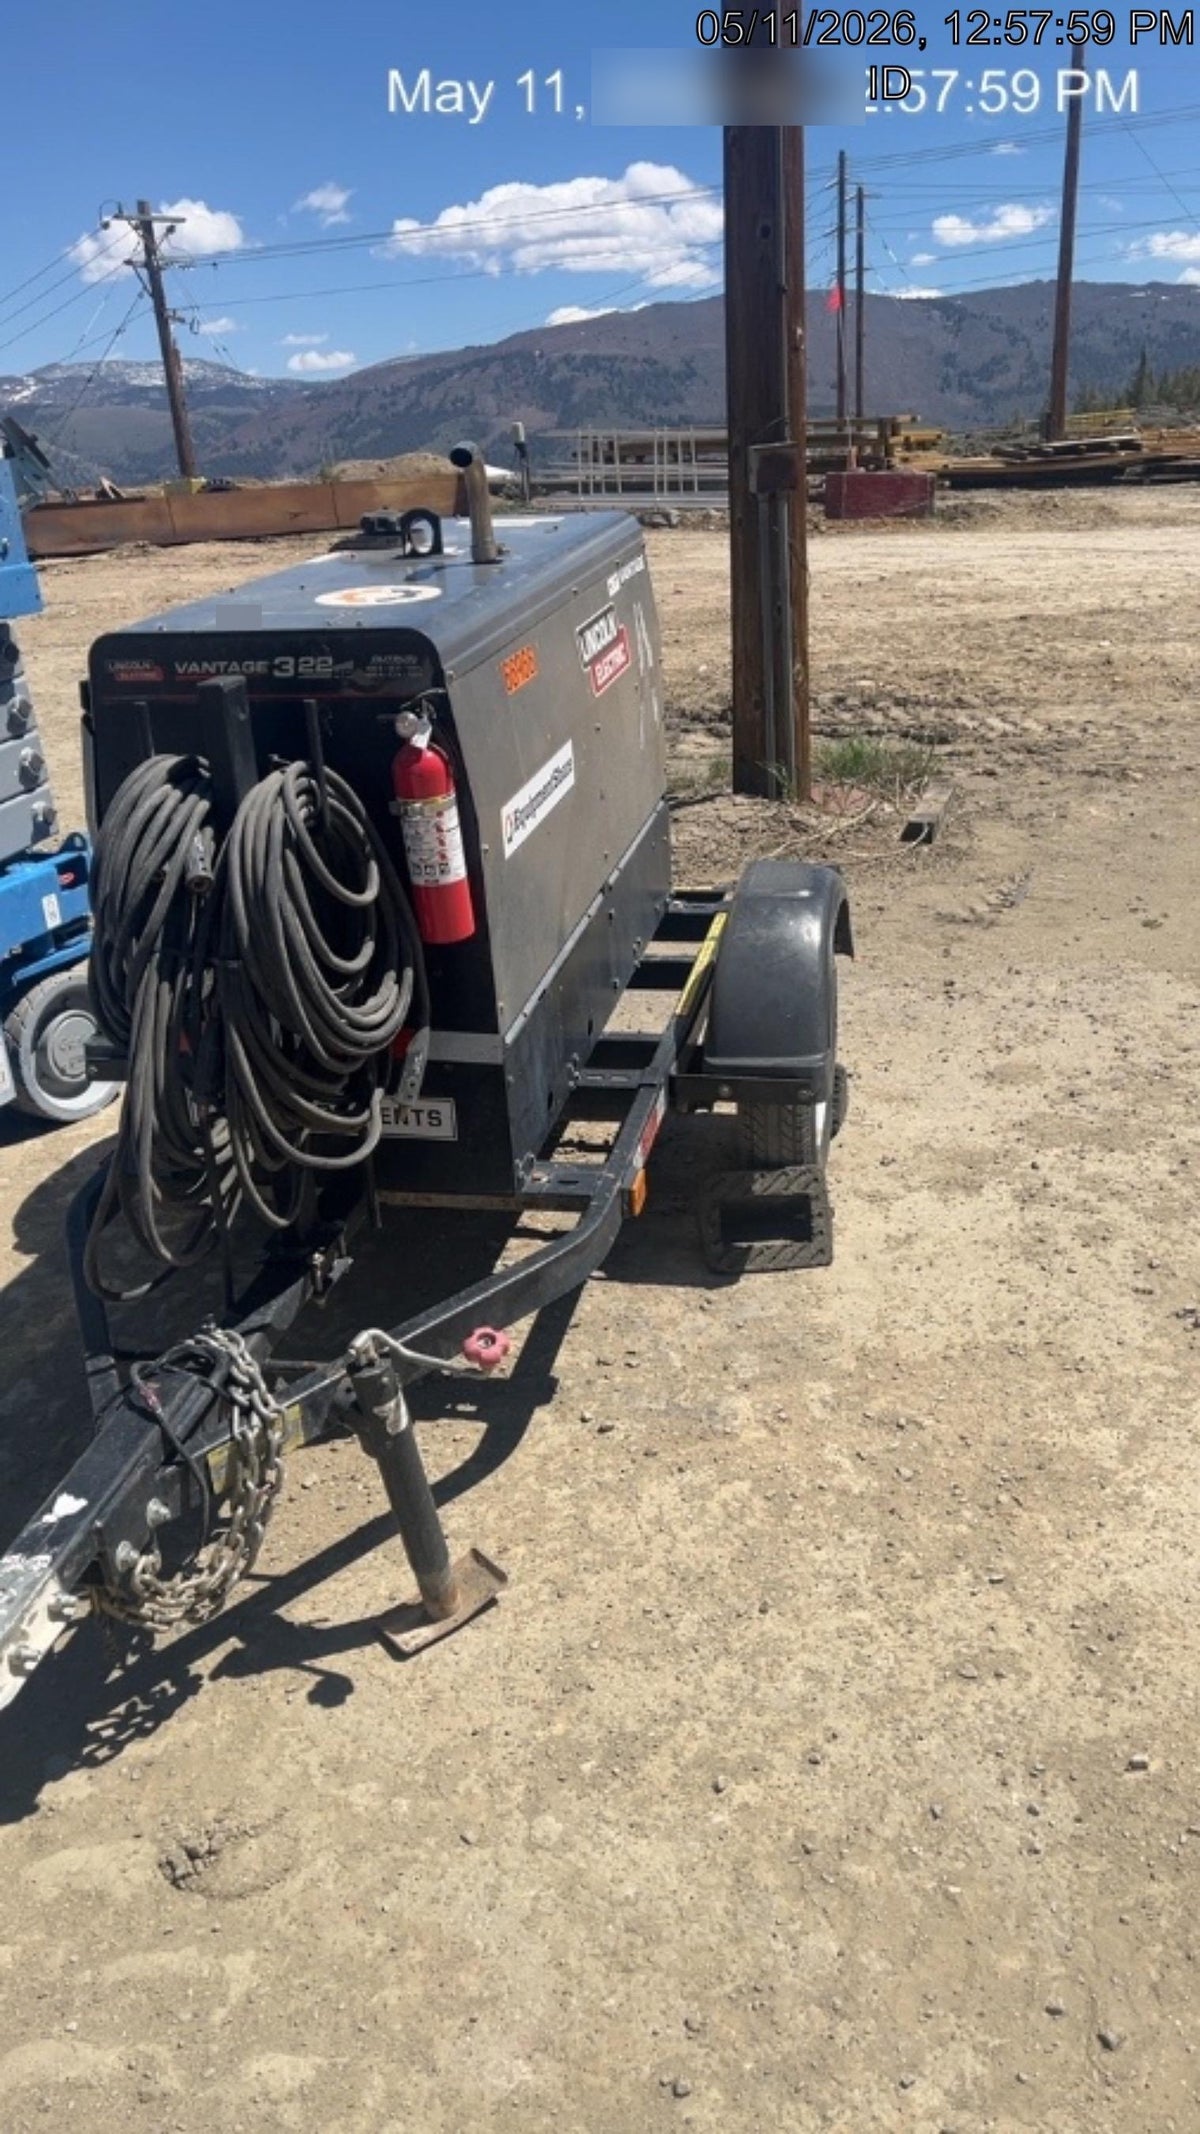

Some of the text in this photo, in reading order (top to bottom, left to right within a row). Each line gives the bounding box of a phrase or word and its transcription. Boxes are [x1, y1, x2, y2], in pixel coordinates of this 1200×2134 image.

[174, 656, 334, 678] VANTAGE 322
[380, 1106, 443, 1127] ENTS
